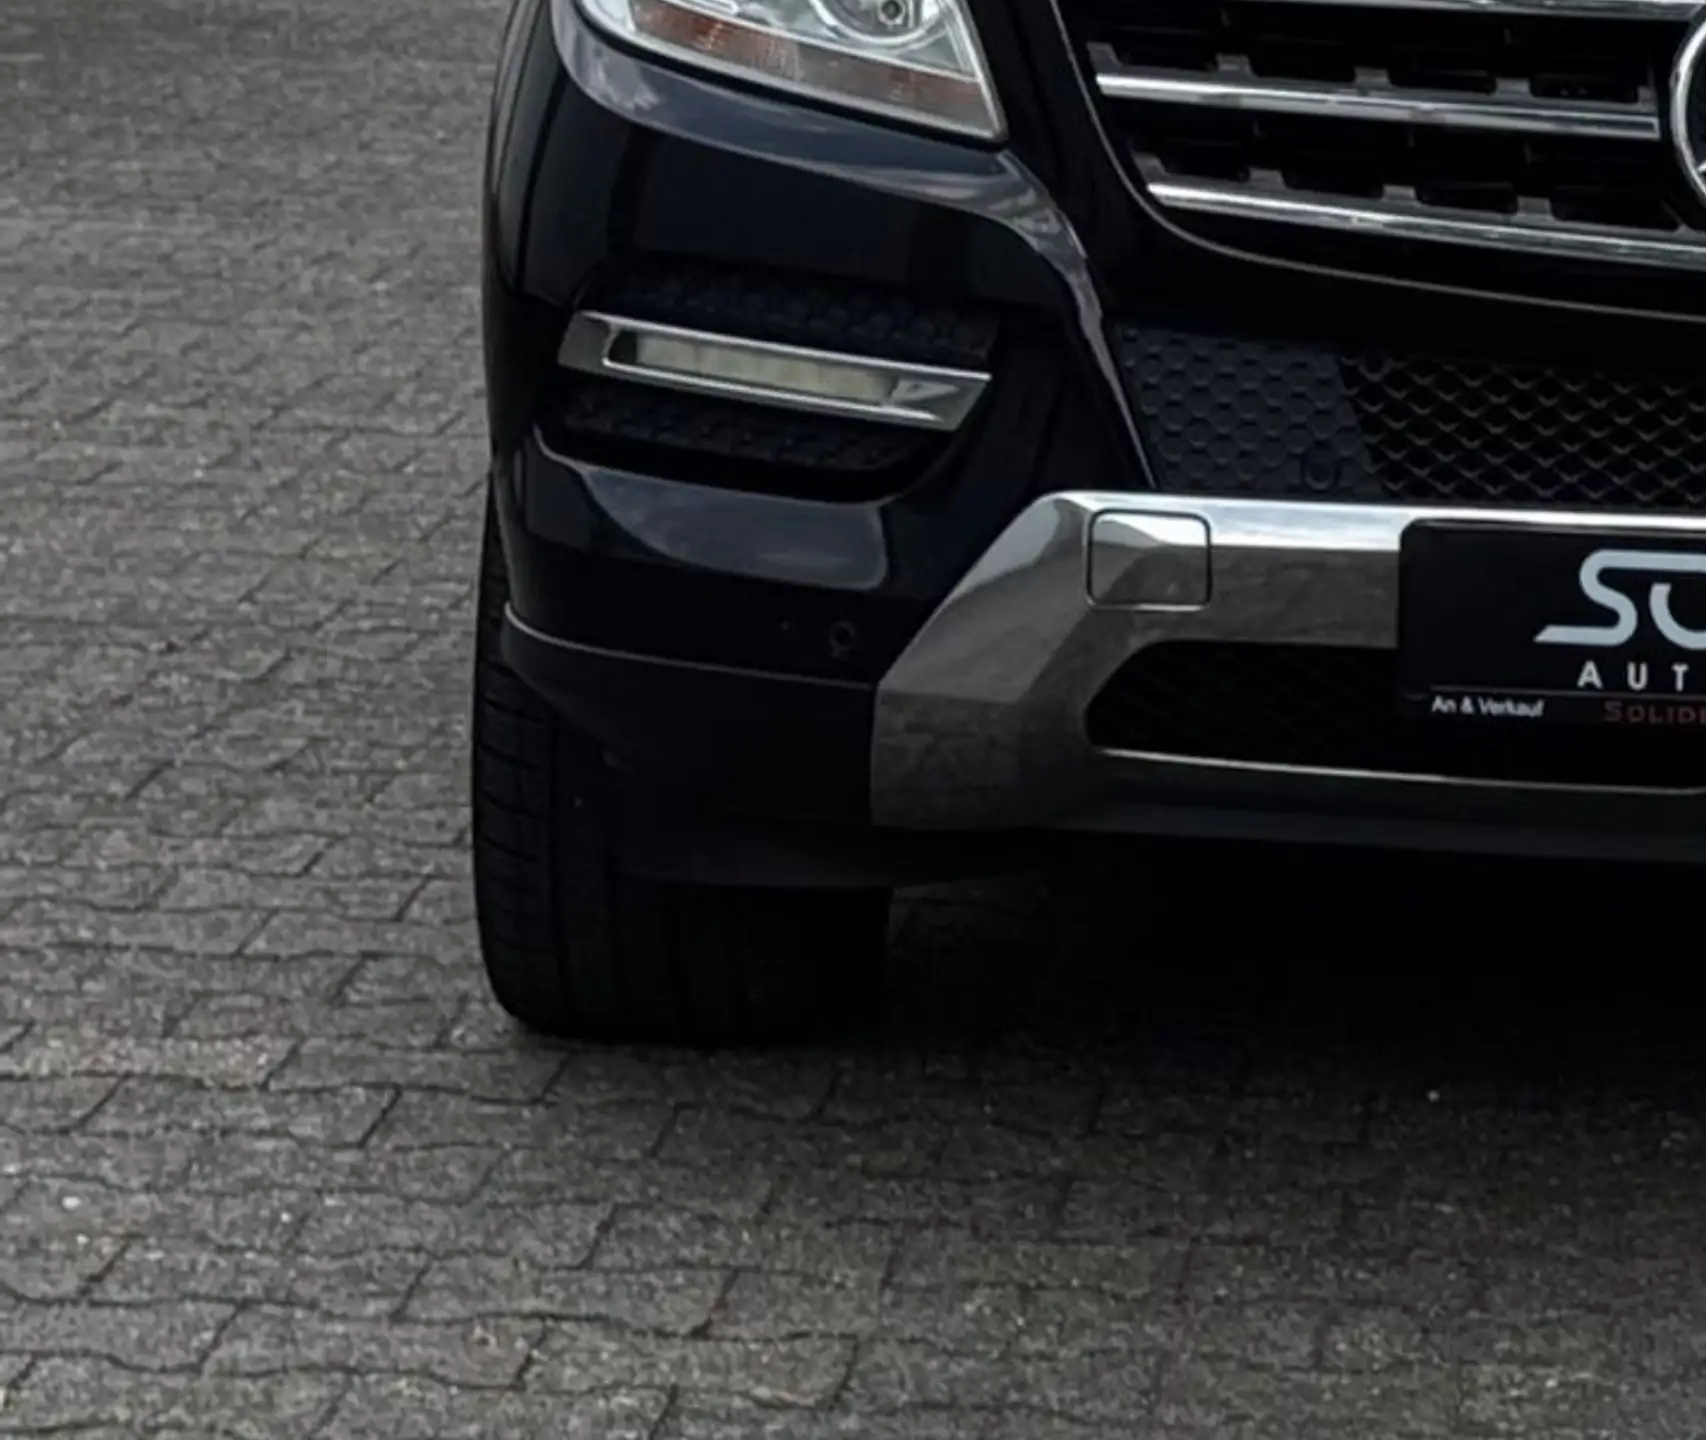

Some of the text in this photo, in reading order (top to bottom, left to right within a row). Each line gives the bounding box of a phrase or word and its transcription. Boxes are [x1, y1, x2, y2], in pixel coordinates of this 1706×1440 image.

[1431, 695, 1545, 718] An & Verkauf
